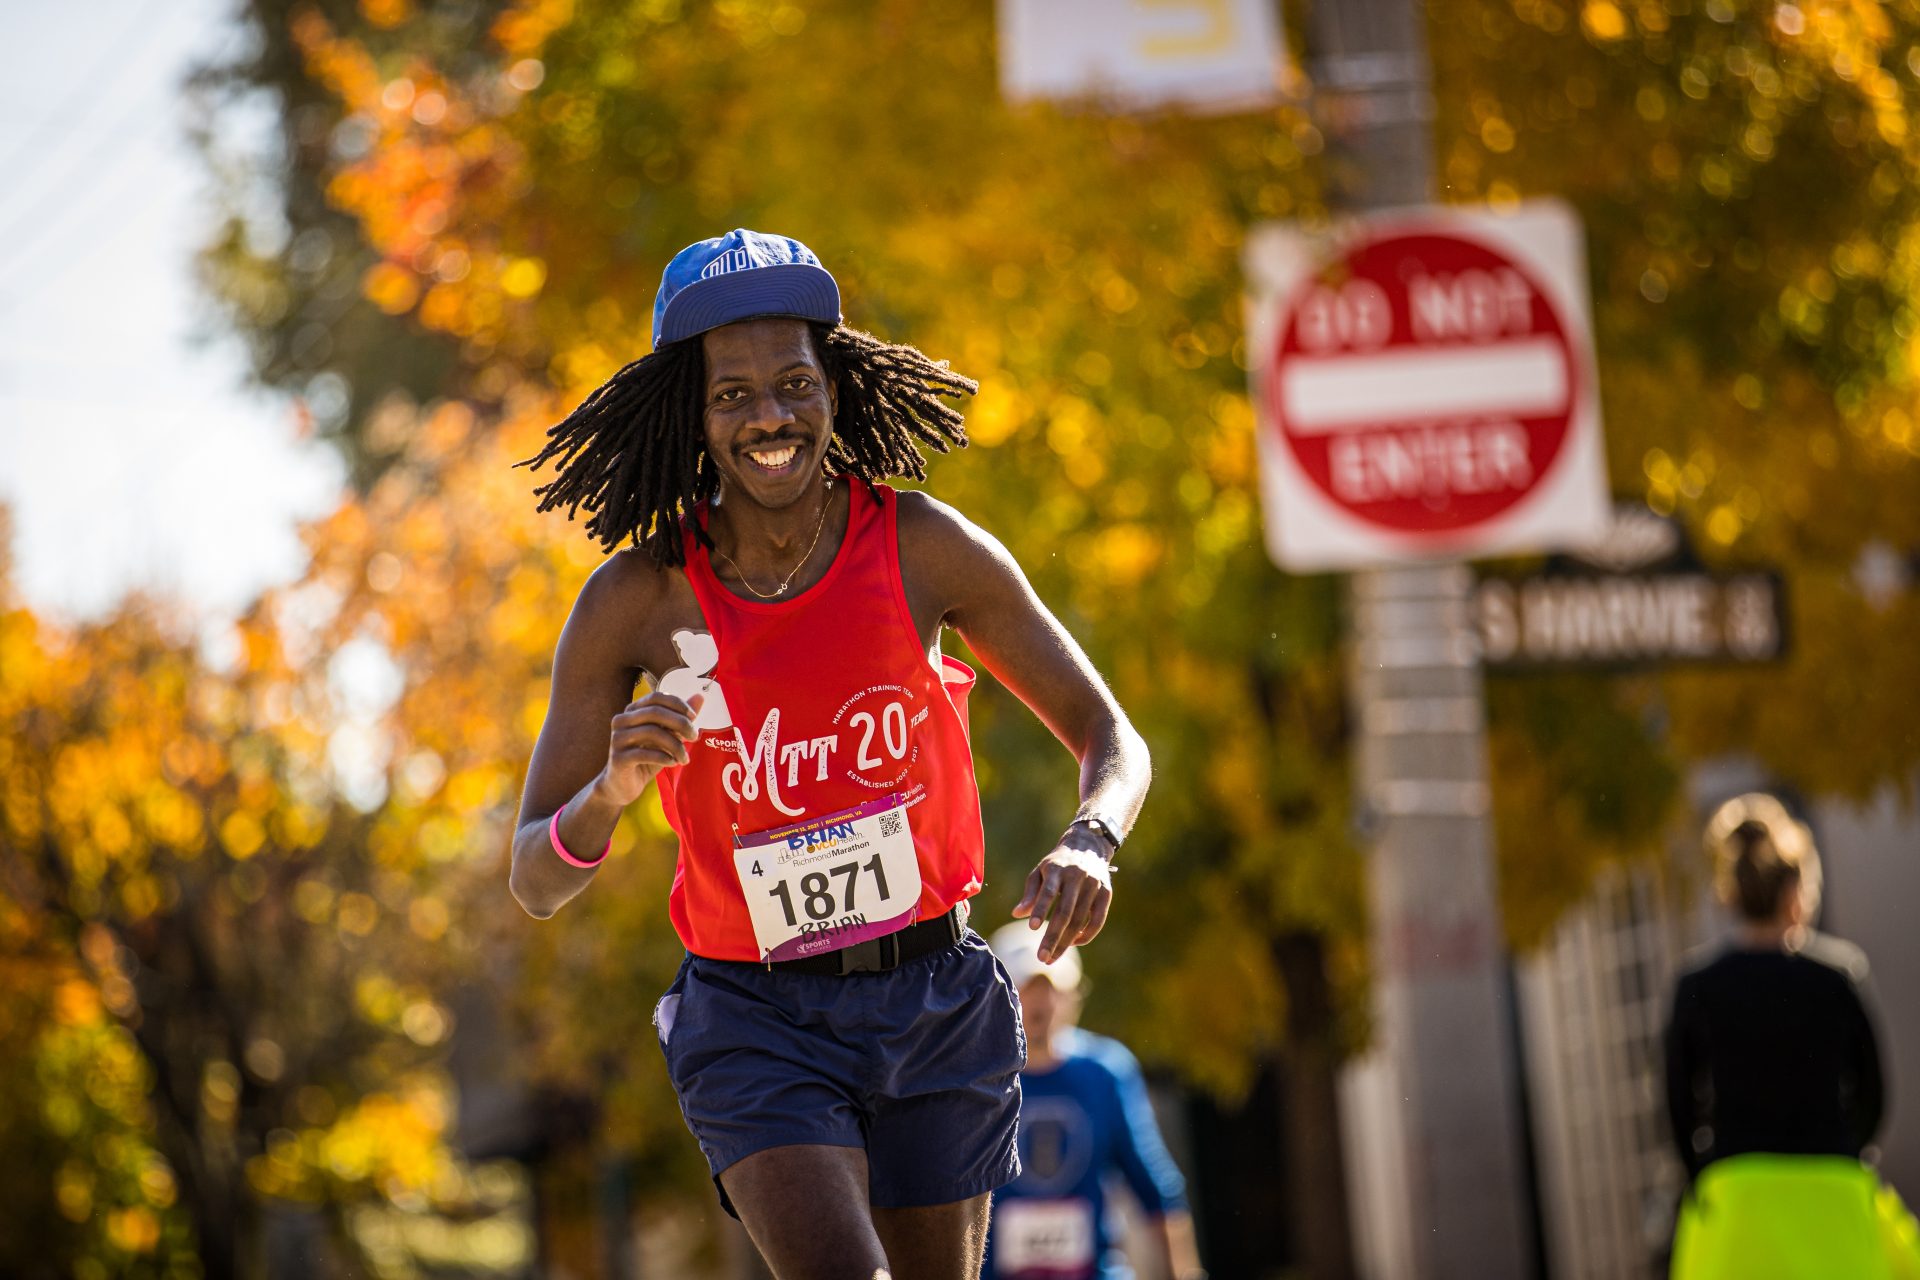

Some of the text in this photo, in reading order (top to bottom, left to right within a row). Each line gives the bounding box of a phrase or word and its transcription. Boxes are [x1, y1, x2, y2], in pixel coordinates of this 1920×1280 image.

[1297, 267, 1533, 350] DO NOT
[1328, 420, 1533, 503] ENTER
[832, 684, 914, 724] MARATHON TRAINING TEAM
[715, 738, 740, 748] SPOR
[849, 702, 929, 771] 20 YEARS
[722, 707, 838, 816] MTT
[846, 770, 894, 789] ESTABLISHED
[787, 822, 856, 850] BRIAN
[751, 860, 764, 877] 4
[768, 853, 890, 927] 1871
[797, 912, 868, 944] BRIAN
[804, 938, 831, 950] SPORTS
